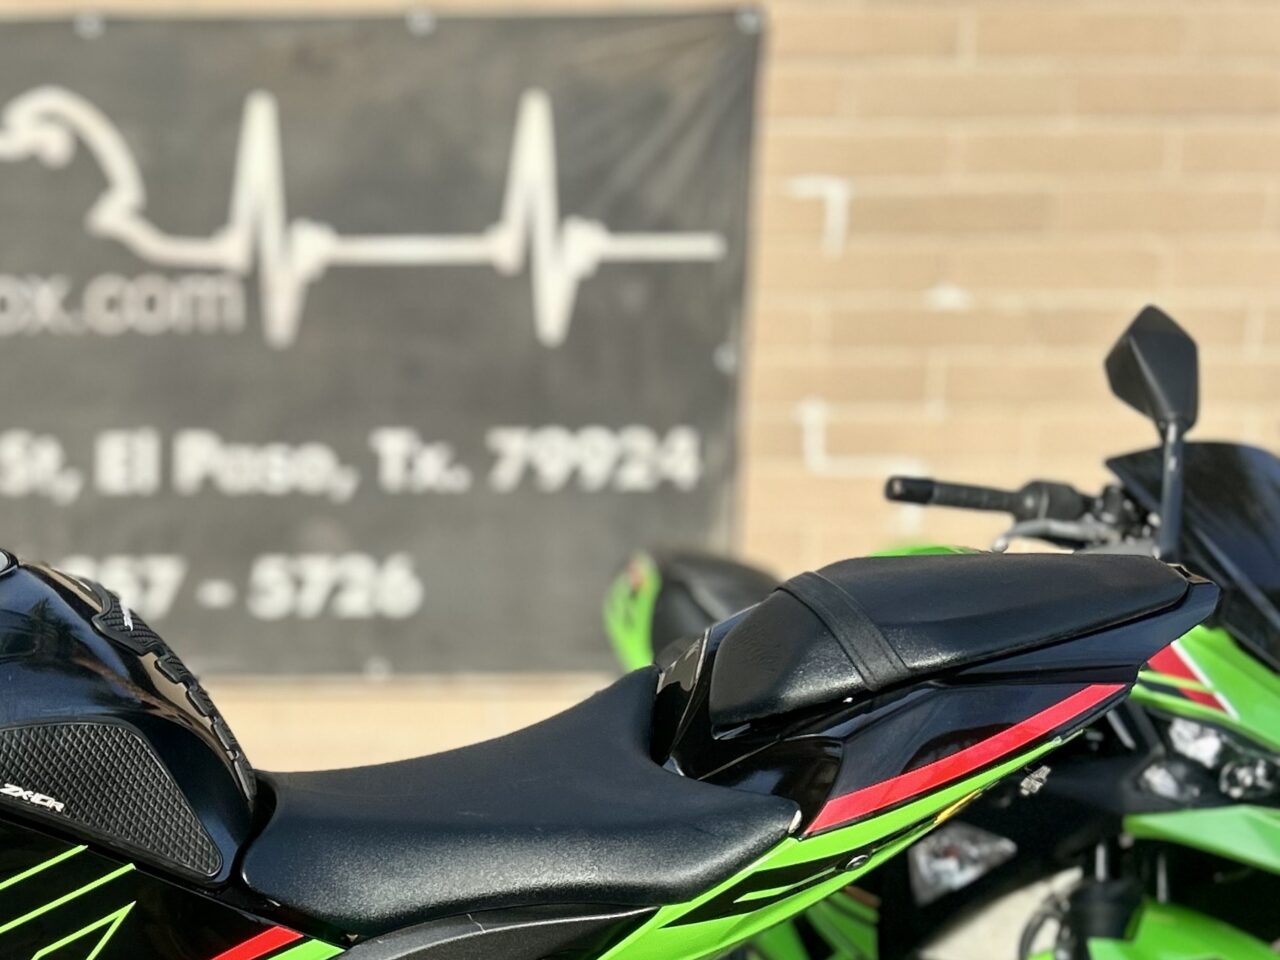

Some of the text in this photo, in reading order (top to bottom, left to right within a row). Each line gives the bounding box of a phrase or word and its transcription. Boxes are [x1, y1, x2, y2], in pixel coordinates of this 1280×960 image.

[94, 427, 161, 496] El
[172, 427, 360, 503] Paso,
[486, 424, 703, 492] 79924
[246, 552, 425, 622] 5726
